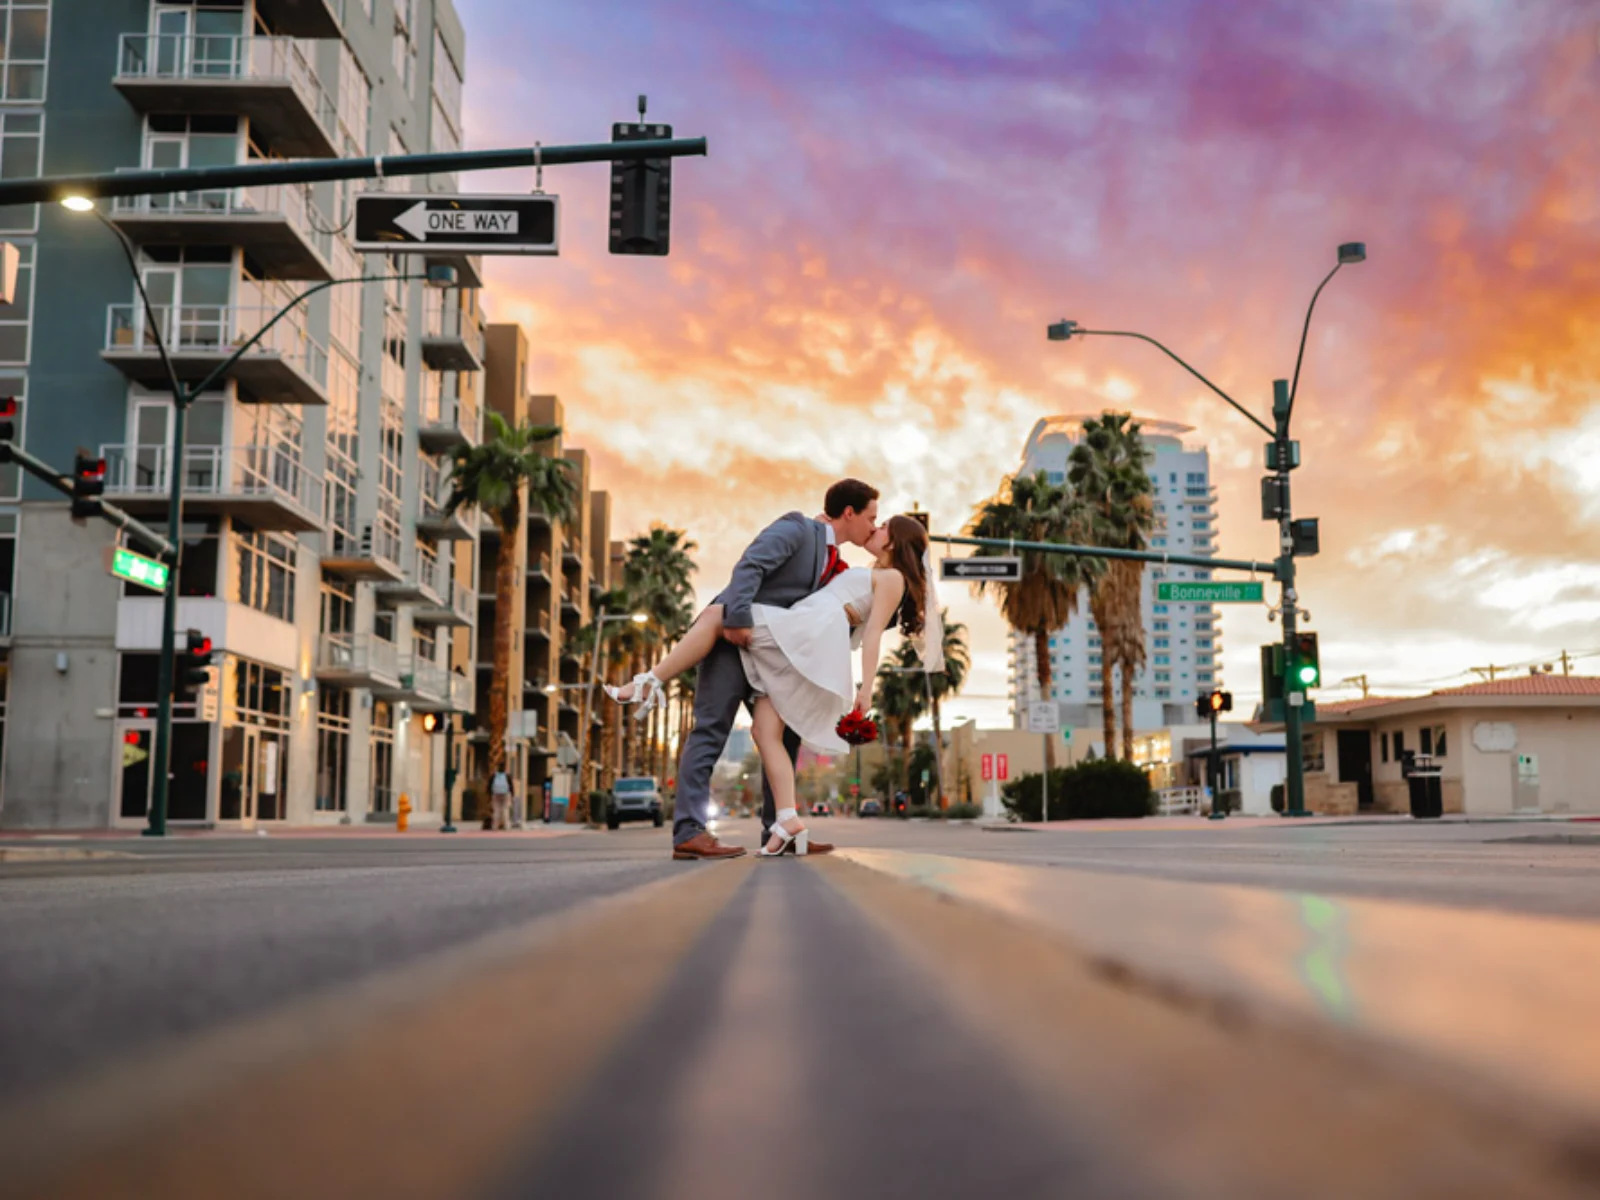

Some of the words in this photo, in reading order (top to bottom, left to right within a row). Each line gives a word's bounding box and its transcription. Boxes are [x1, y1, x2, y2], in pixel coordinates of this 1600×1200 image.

[428, 212, 466, 230] ONE
[473, 212, 512, 230] WAY
[1170, 584, 1241, 599] Bonneville
